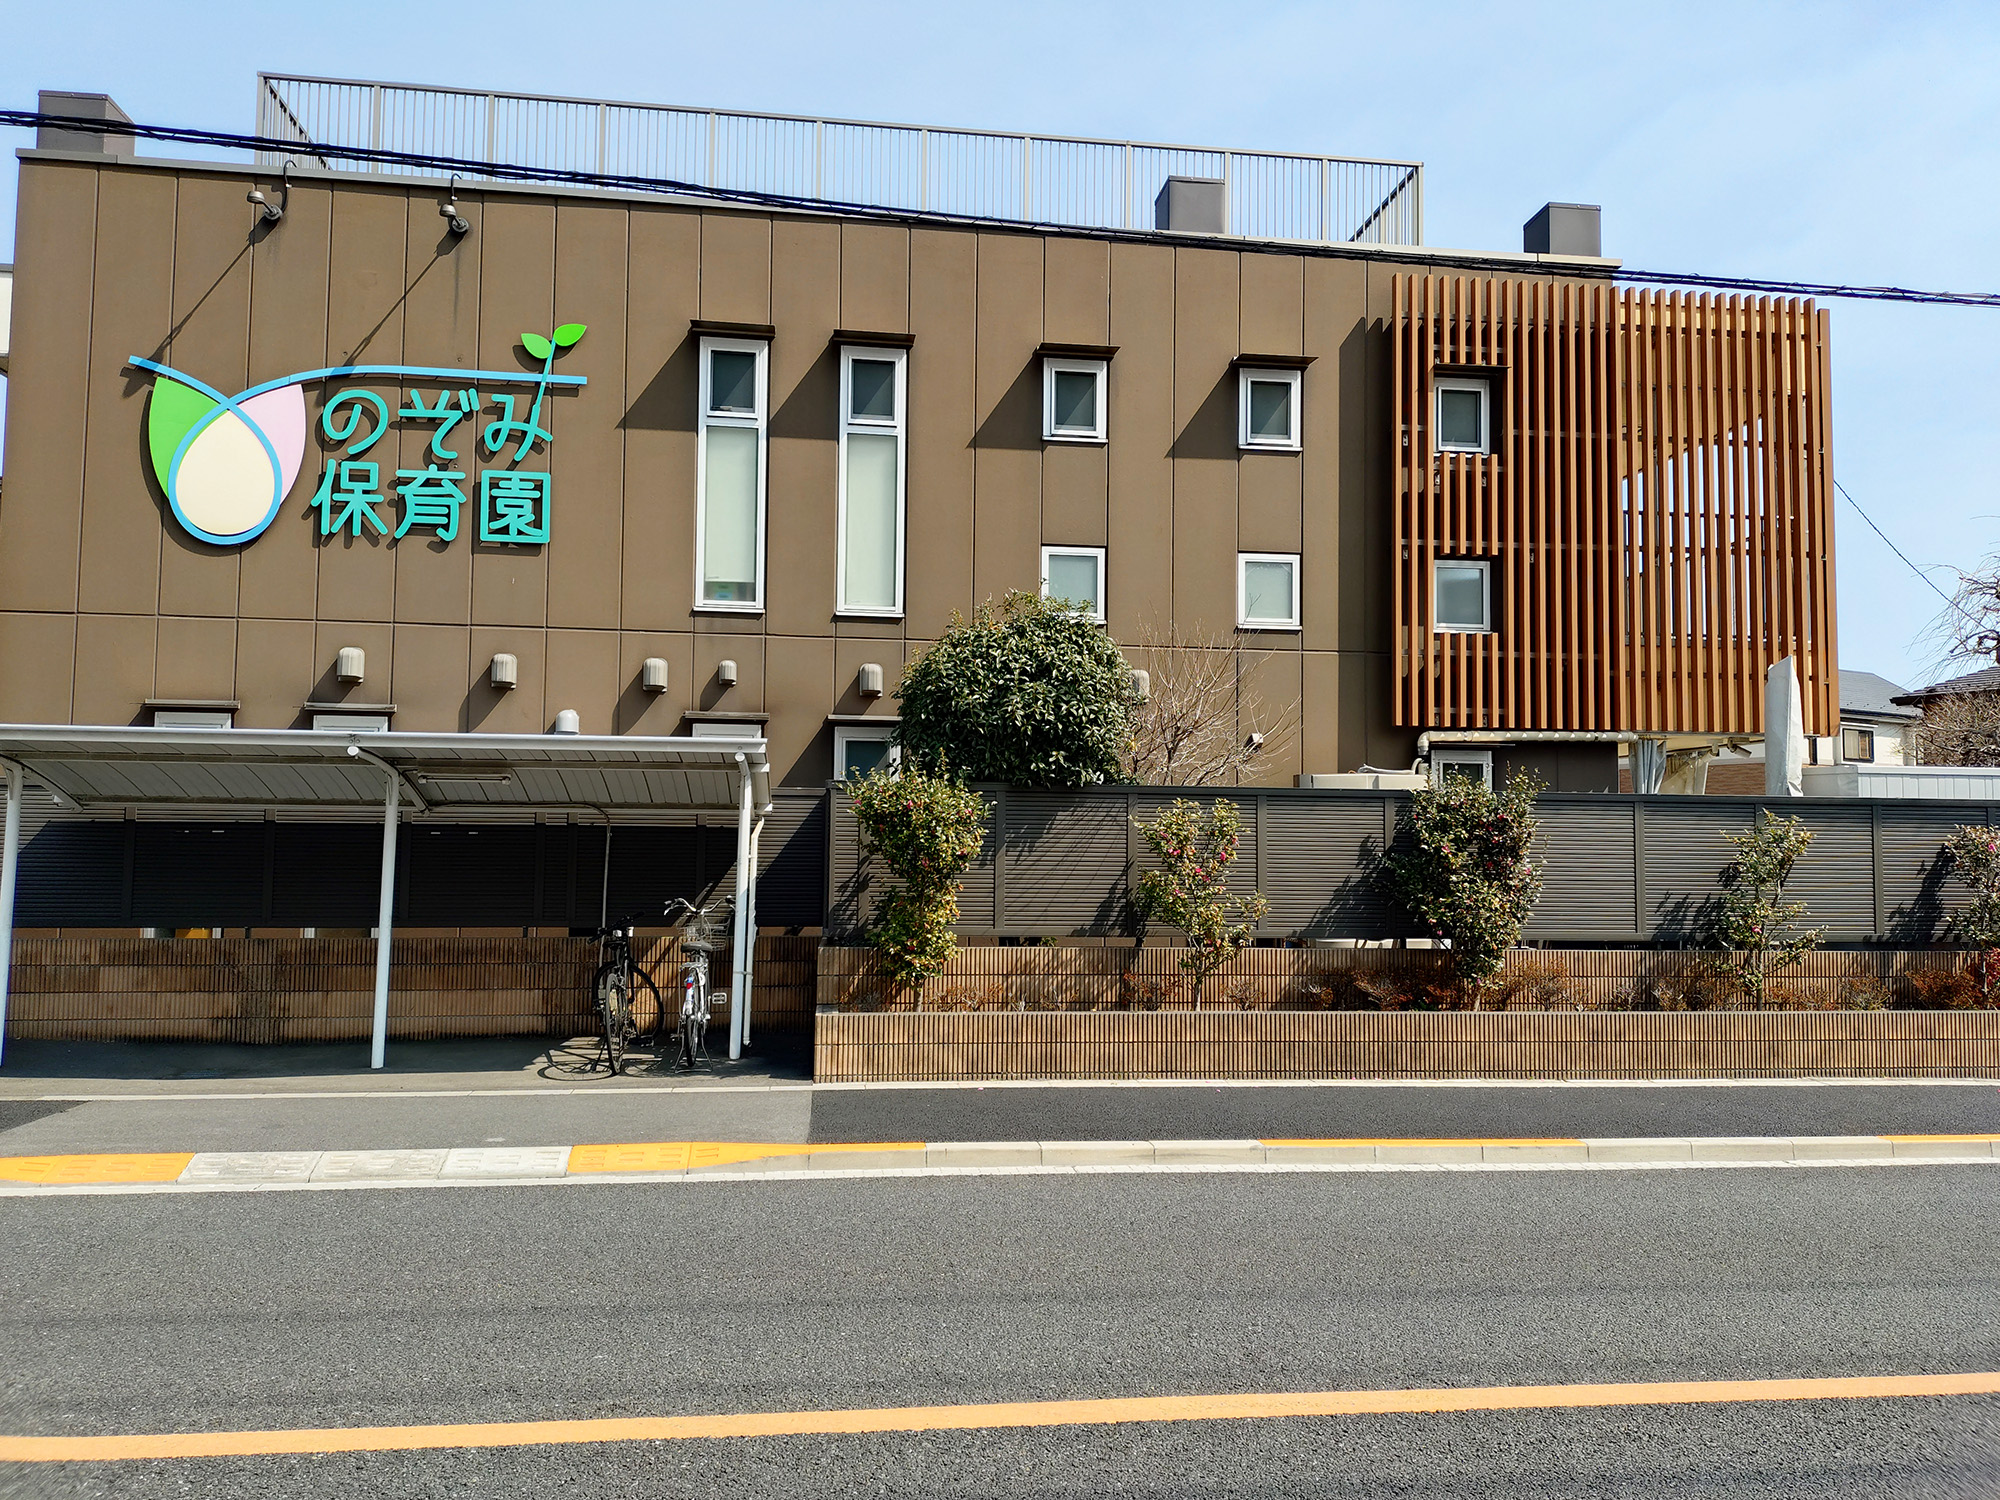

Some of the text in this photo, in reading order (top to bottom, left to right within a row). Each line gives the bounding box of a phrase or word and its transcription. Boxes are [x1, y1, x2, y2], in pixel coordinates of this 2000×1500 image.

[322, 388, 553, 462] のぞみ
[311, 458, 551, 544] 保育園
